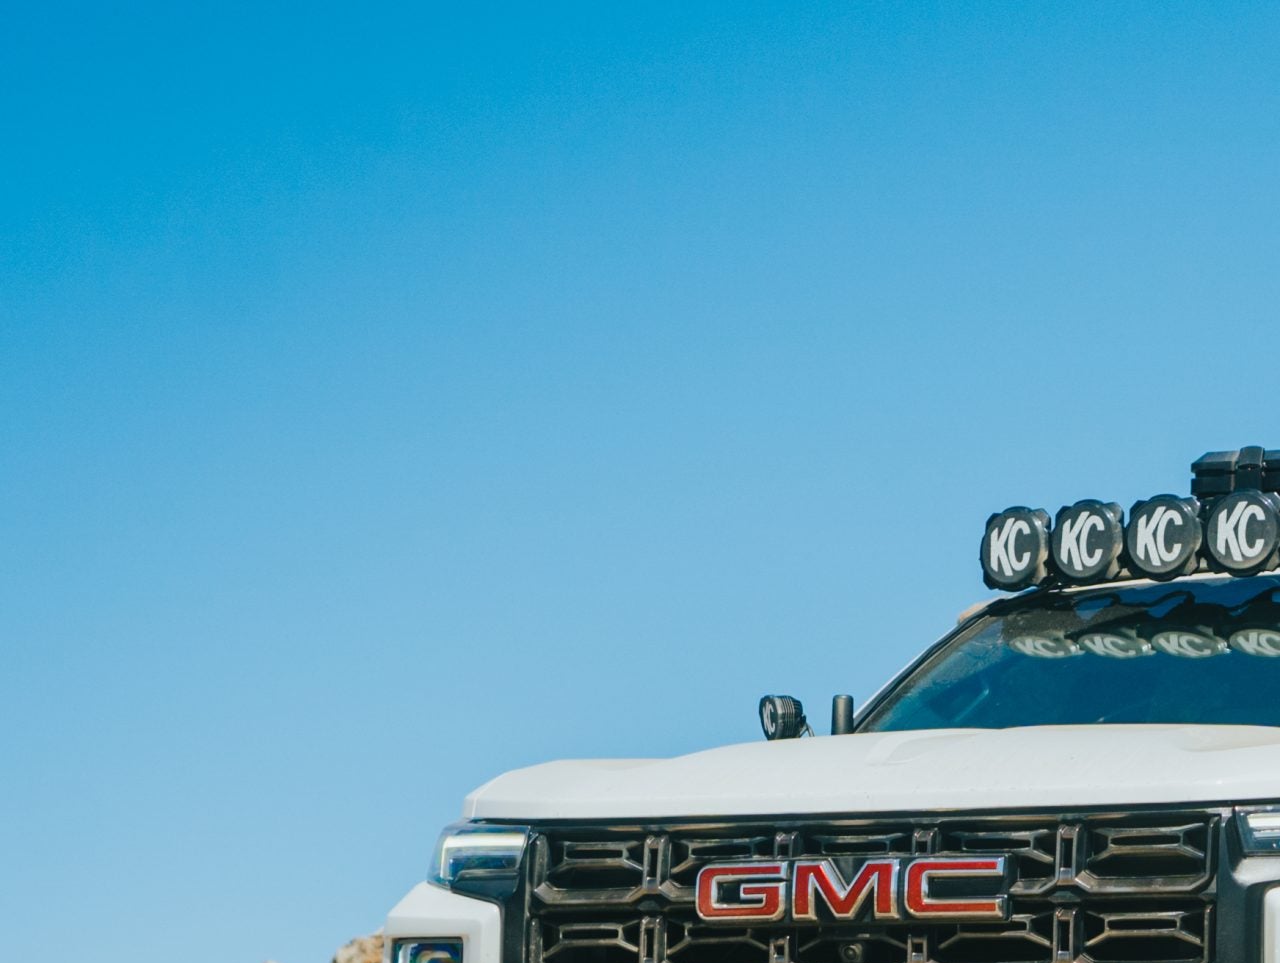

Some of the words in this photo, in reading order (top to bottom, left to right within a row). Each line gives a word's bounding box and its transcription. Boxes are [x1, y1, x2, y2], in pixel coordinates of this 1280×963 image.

[990, 517, 1031, 576] KC
[1060, 511, 1105, 571] KC
[1136, 506, 1183, 566] KC
[1216, 501, 1266, 562] KC
[762, 701, 776, 735] KC
[695, 856, 1006, 920] GMC
